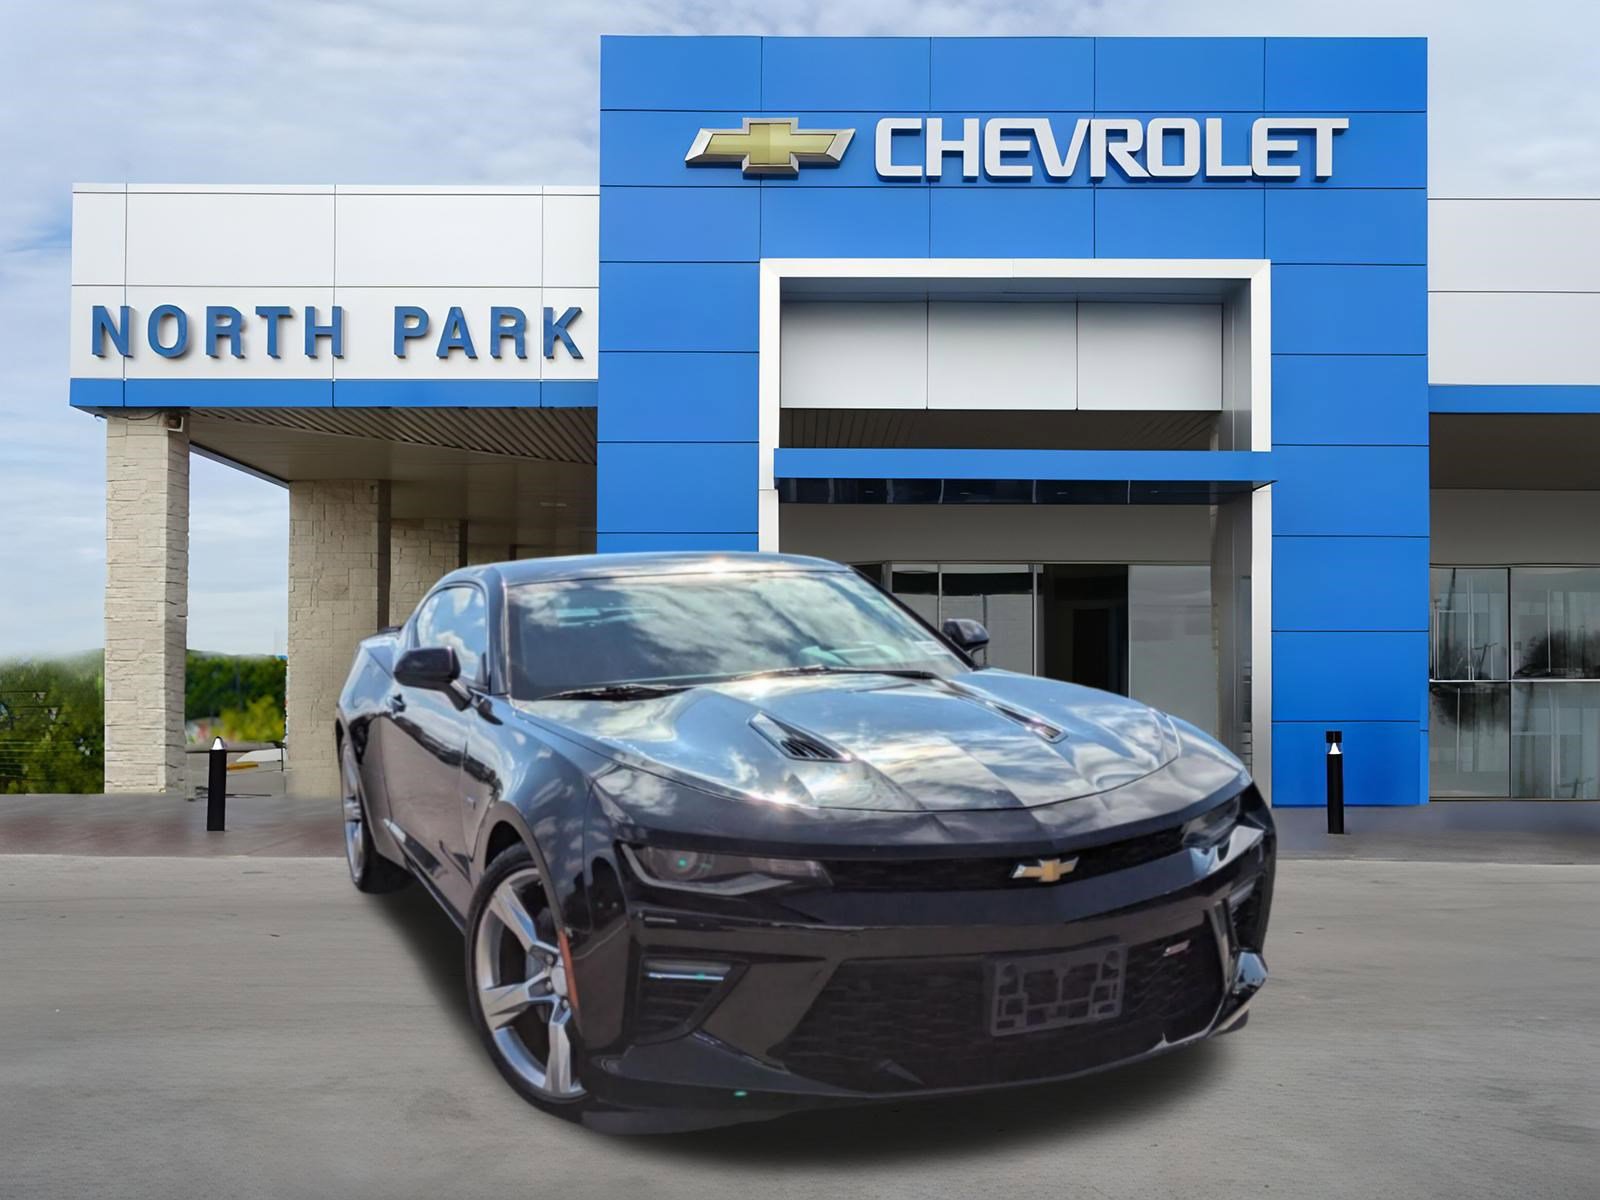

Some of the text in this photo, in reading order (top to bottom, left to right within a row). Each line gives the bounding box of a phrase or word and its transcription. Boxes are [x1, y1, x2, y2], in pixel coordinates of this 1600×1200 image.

[874, 116, 1350, 180] CHEVROLET
[92, 304, 585, 360] NORTH PARK
